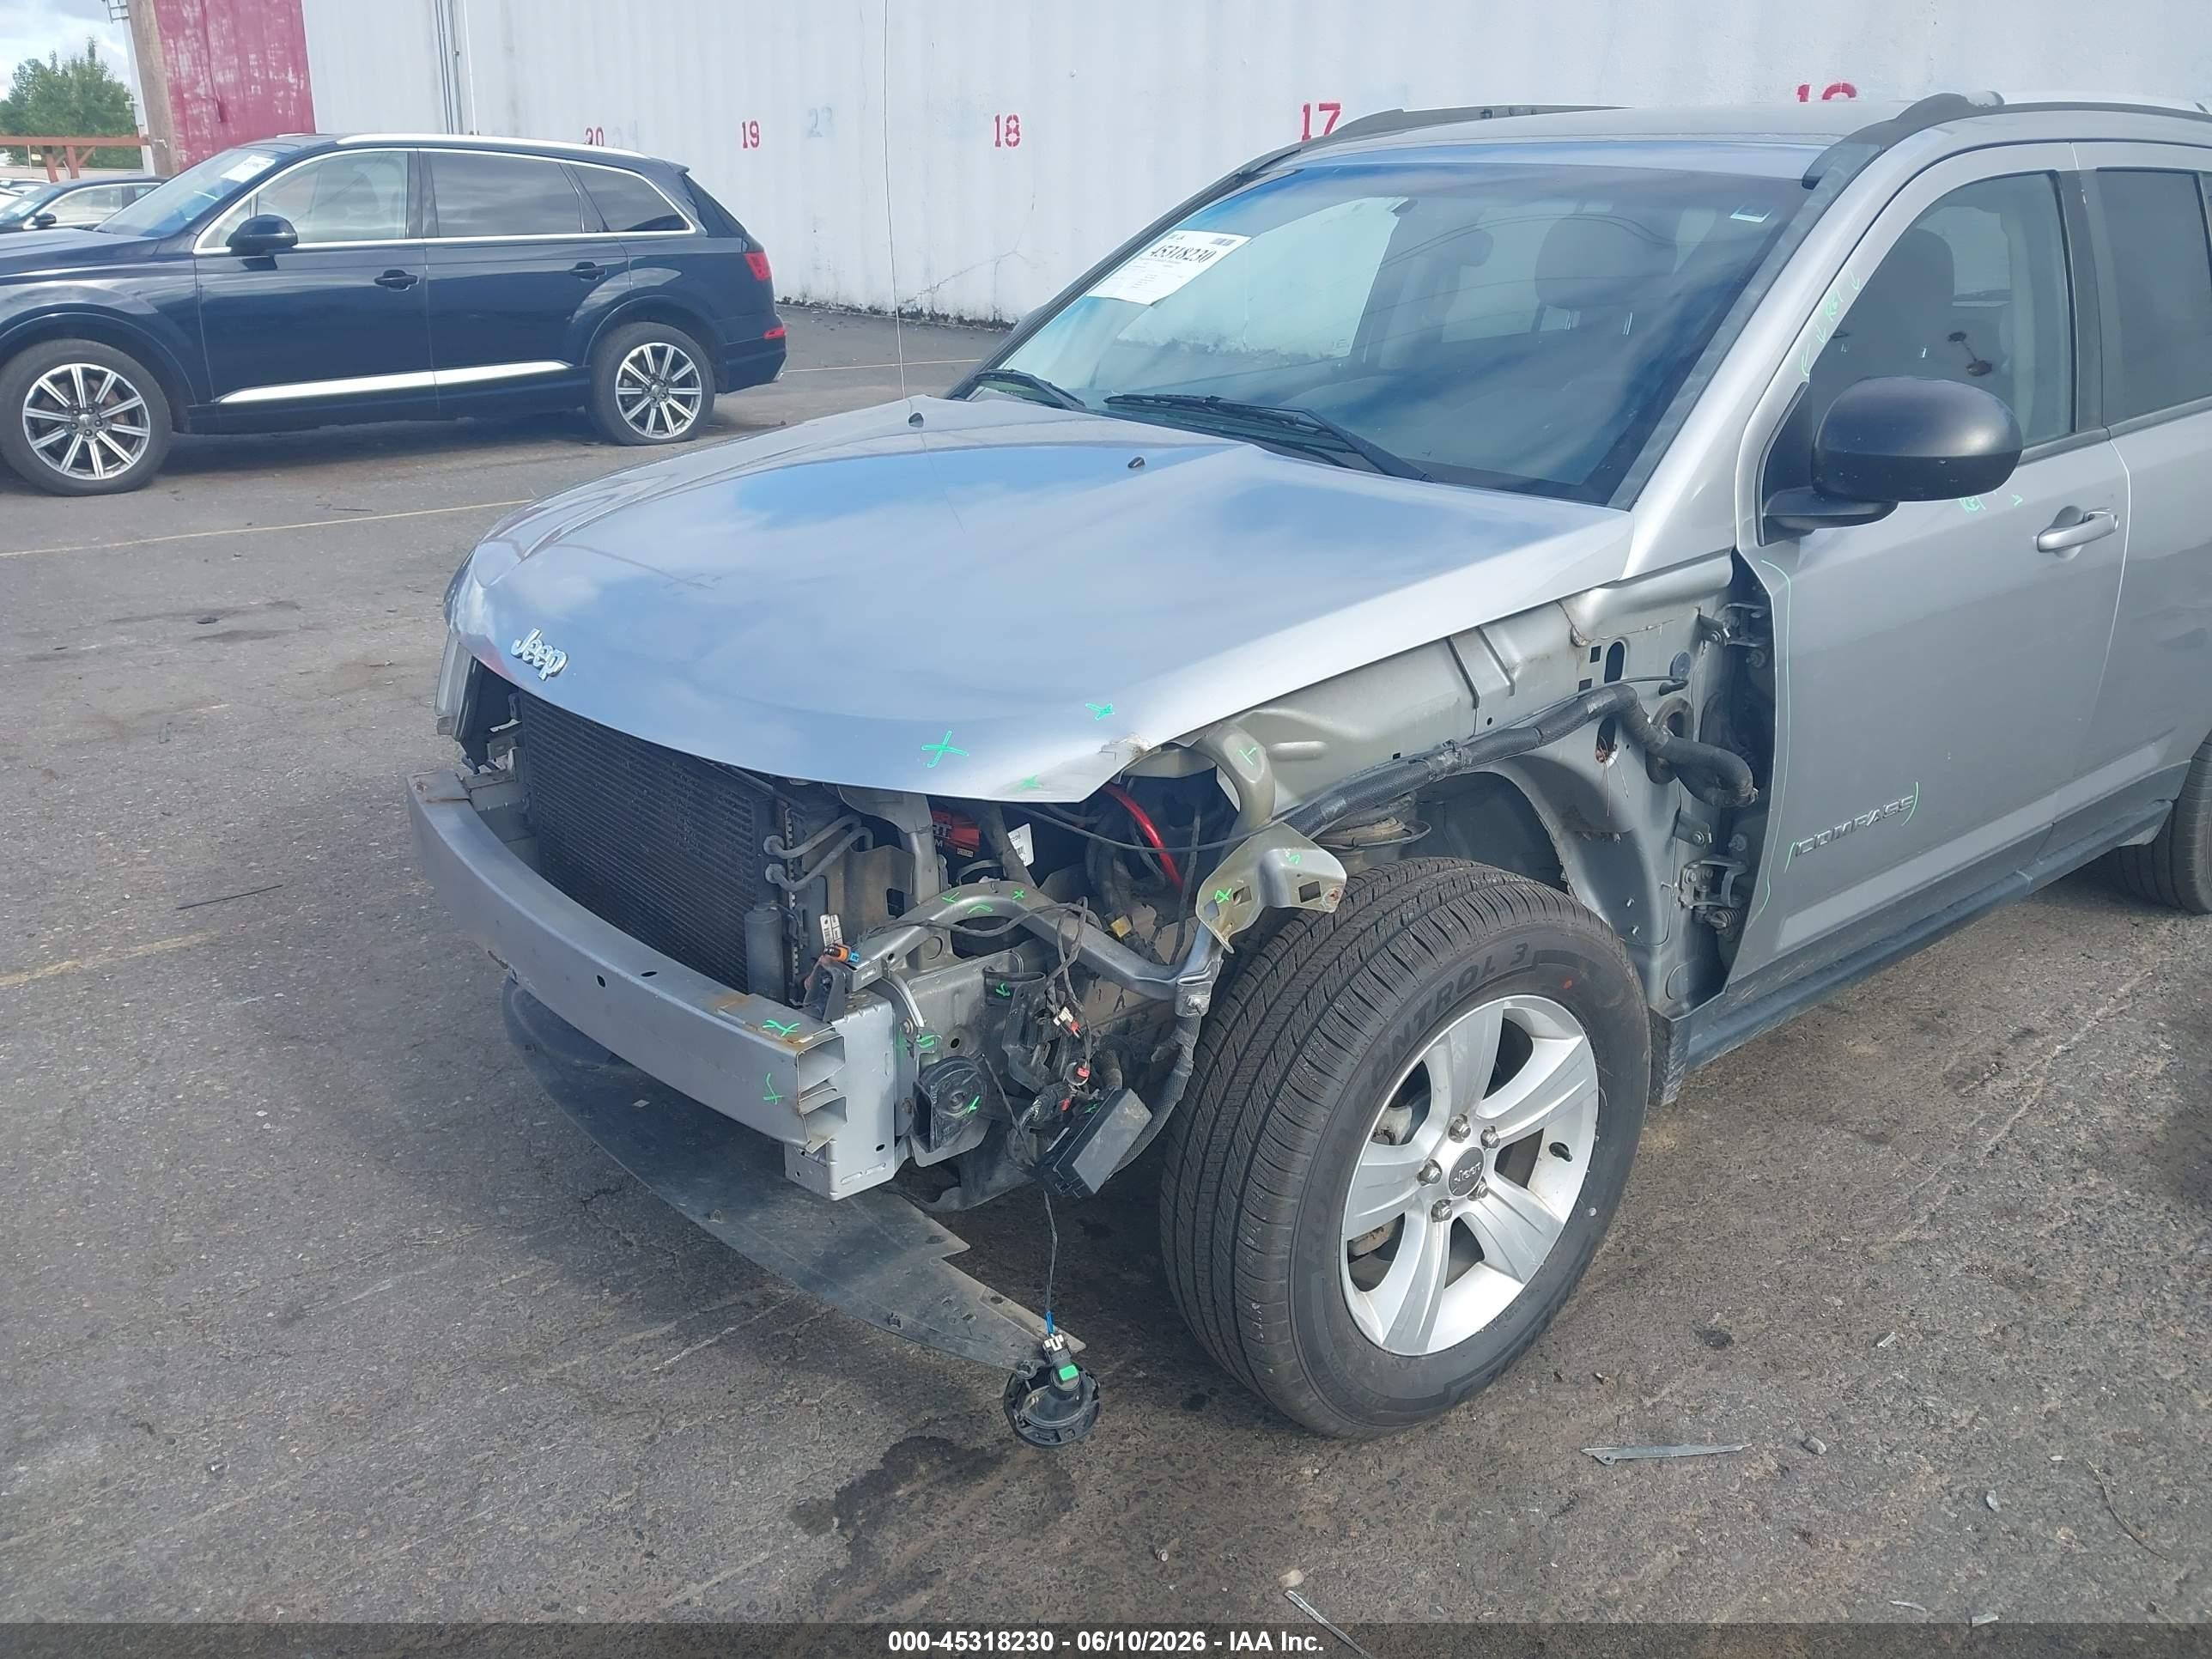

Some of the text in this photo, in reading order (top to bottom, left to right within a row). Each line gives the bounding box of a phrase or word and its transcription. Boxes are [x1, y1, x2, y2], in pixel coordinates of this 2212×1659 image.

[741, 120, 761, 149] 19
[994, 114, 1020, 148] 18
[1302, 102, 1340, 141] 17
[1150, 245, 1218, 263] 45318230
[511, 628, 568, 681] Jeep
[1795, 795, 1914, 857] COMPASS
[1509, 941, 1528, 967] 3
[1454, 1162, 1481, 1182] Jeep
